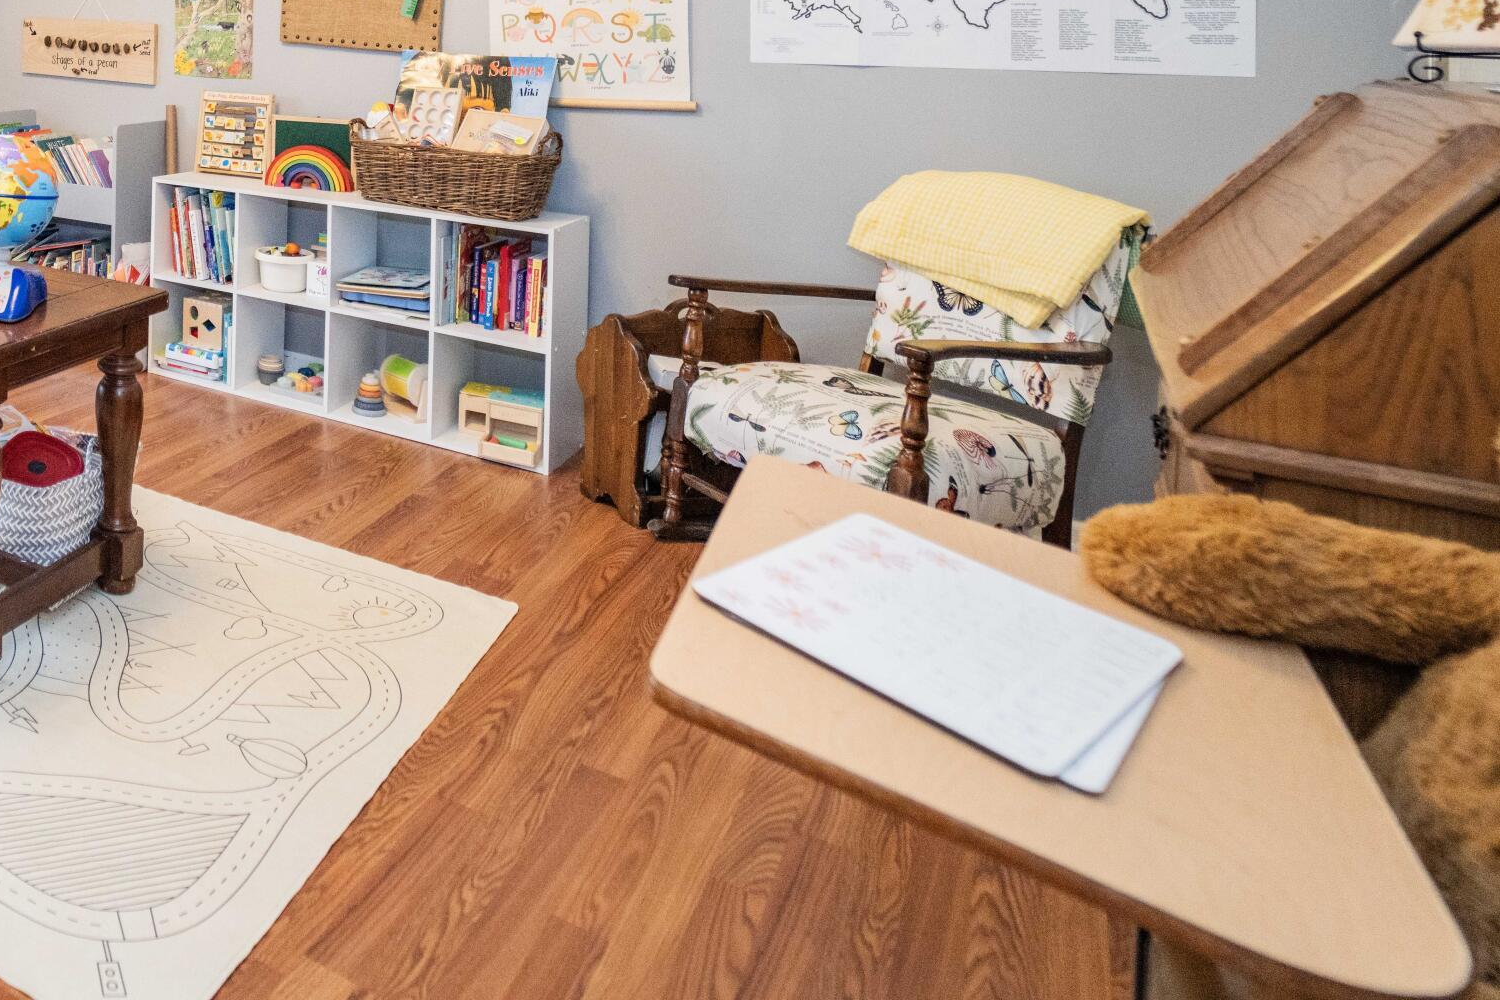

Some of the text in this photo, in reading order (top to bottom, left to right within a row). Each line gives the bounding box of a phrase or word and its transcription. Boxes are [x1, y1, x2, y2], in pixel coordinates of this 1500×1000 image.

[501, 13, 519, 43] P
[611, 12, 633, 44] S
[643, 12, 667, 43] T
[77, 54, 87, 66] of
[97, 59, 118, 70] pecan
[488, 60, 545, 77] Senses
[613, 52, 634, 85] Y
[518, 87, 540, 97] Aliki
